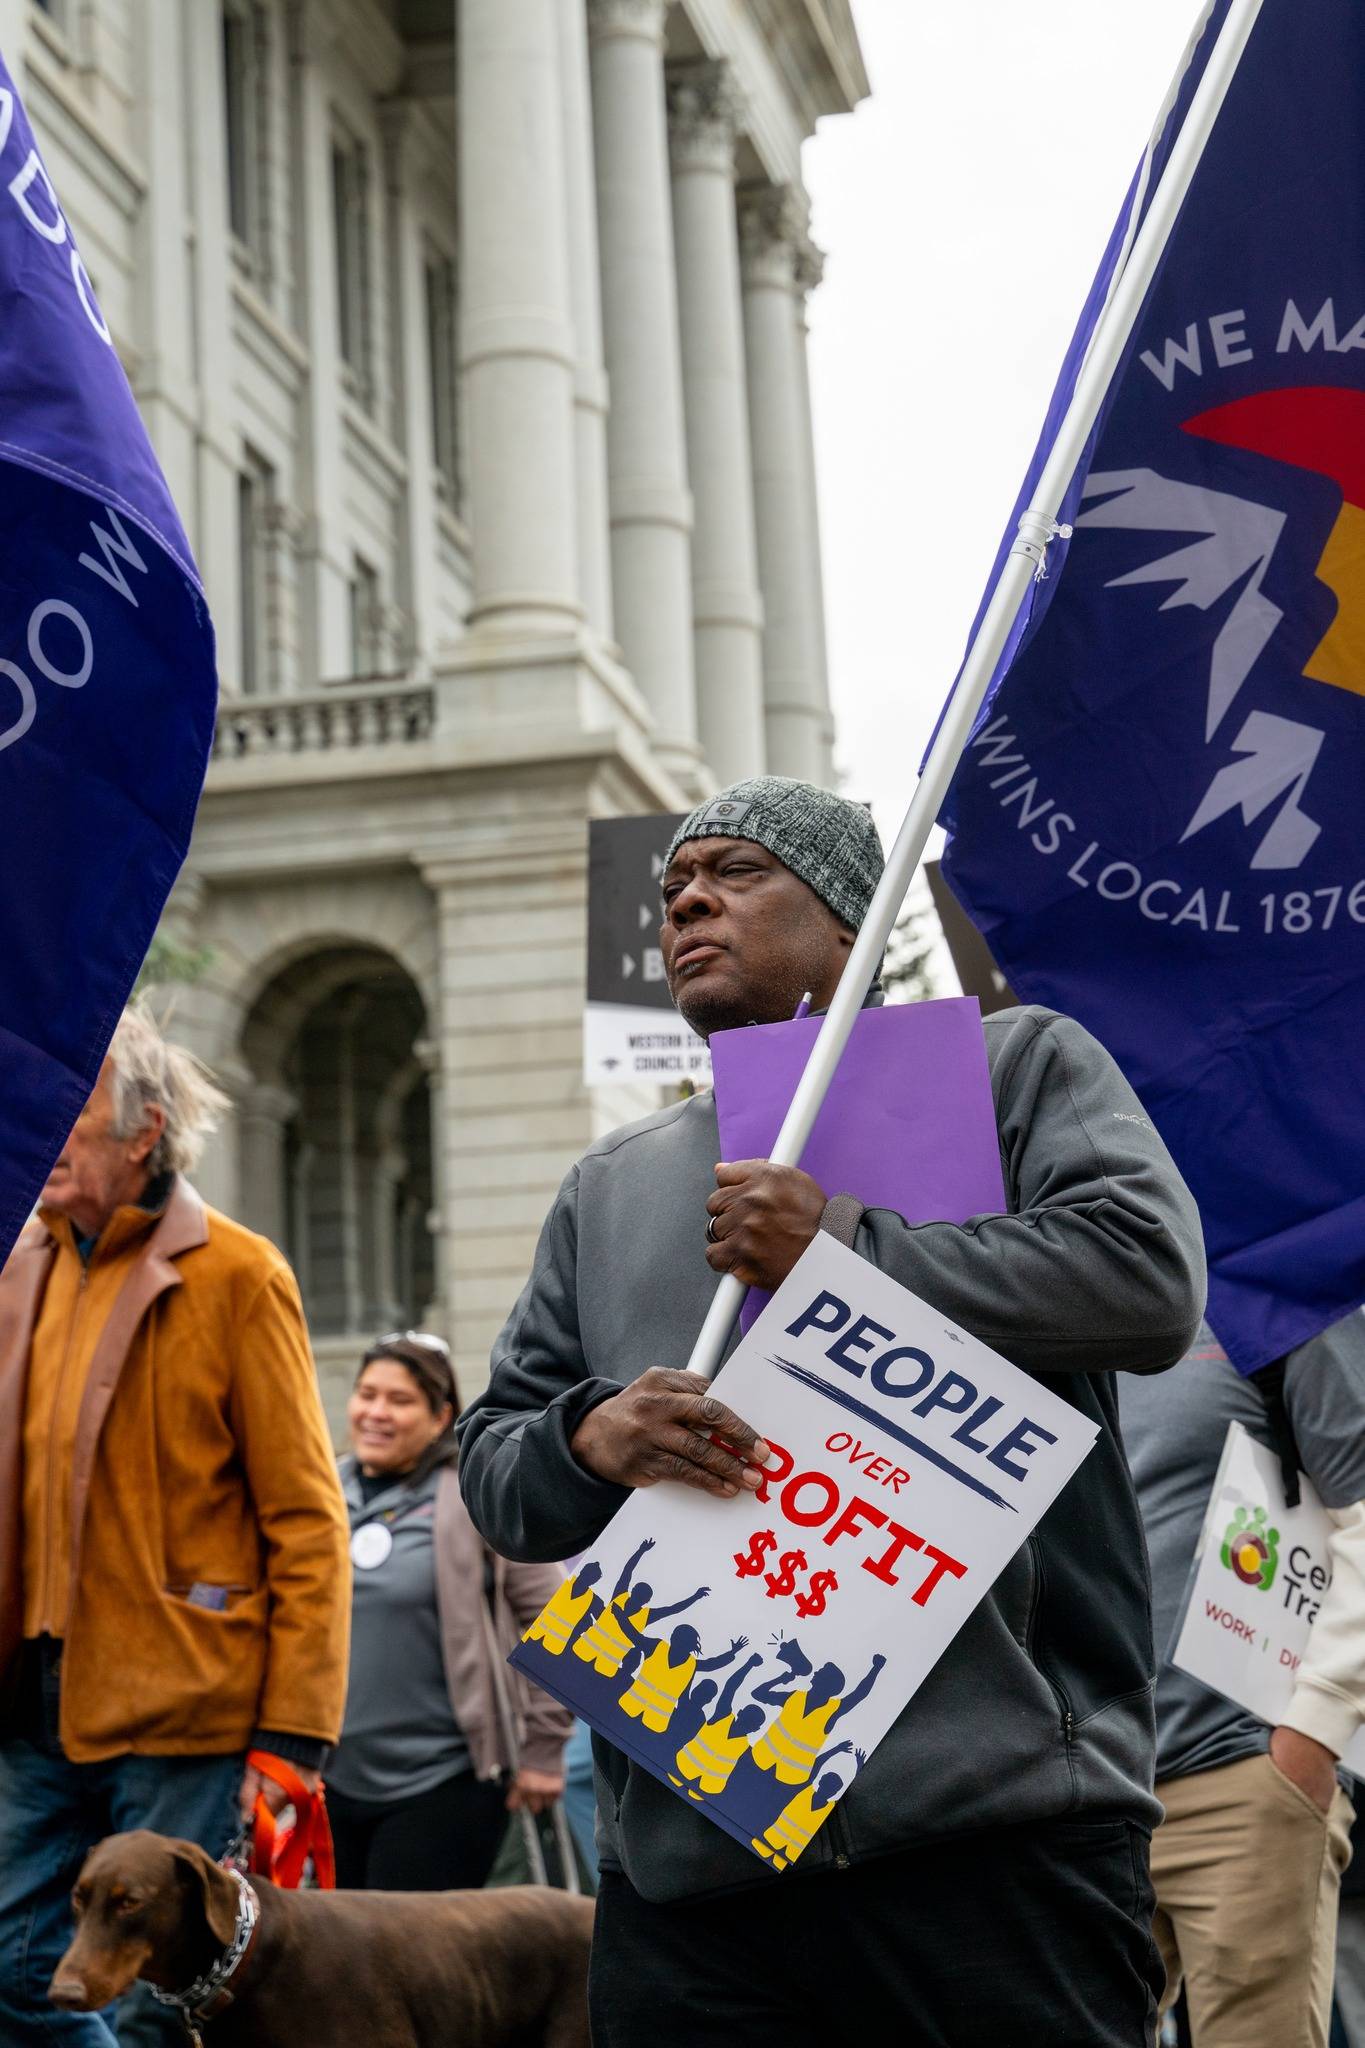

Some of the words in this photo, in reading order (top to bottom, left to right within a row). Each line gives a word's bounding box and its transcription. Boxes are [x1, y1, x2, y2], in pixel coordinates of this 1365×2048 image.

[1140, 309, 1253, 391] WE
[971, 714, 1076, 855] WINS
[1067, 841, 1240, 933] LOCAL
[1260, 879, 1365, 934] 1876
[784, 1289, 1058, 1483] PEOPLE
[825, 1432, 911, 1494] OVER
[1288, 1545, 1332, 1591] Ce
[1206, 1599, 1257, 1645] WORK
